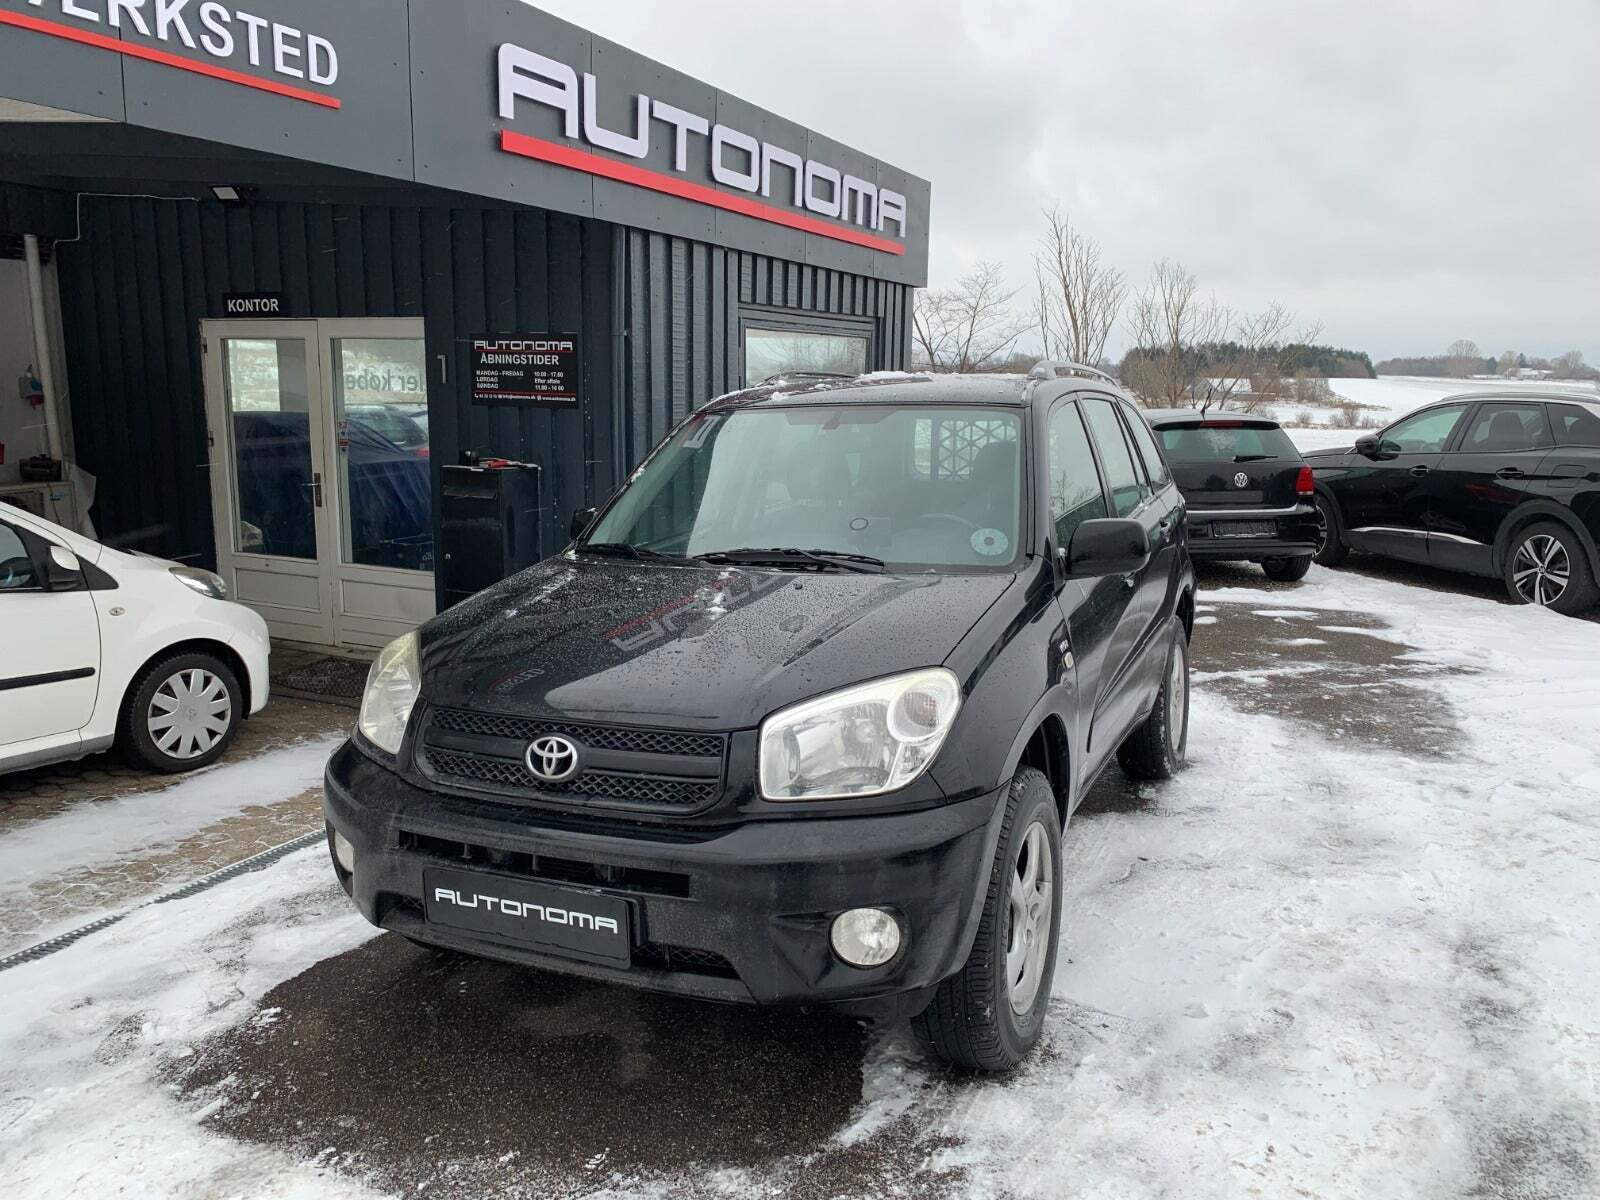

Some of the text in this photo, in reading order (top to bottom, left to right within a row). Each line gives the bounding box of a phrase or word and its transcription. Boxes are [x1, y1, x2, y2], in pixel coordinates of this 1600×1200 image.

[498, 43, 907, 238] AUTONOMA
[227, 298, 279, 312] KONTOR
[474, 340, 573, 351] AUTONOMA
[480, 352, 559, 365] ÅBNINGSTIDER
[435, 887, 618, 934] AUTONOMA
